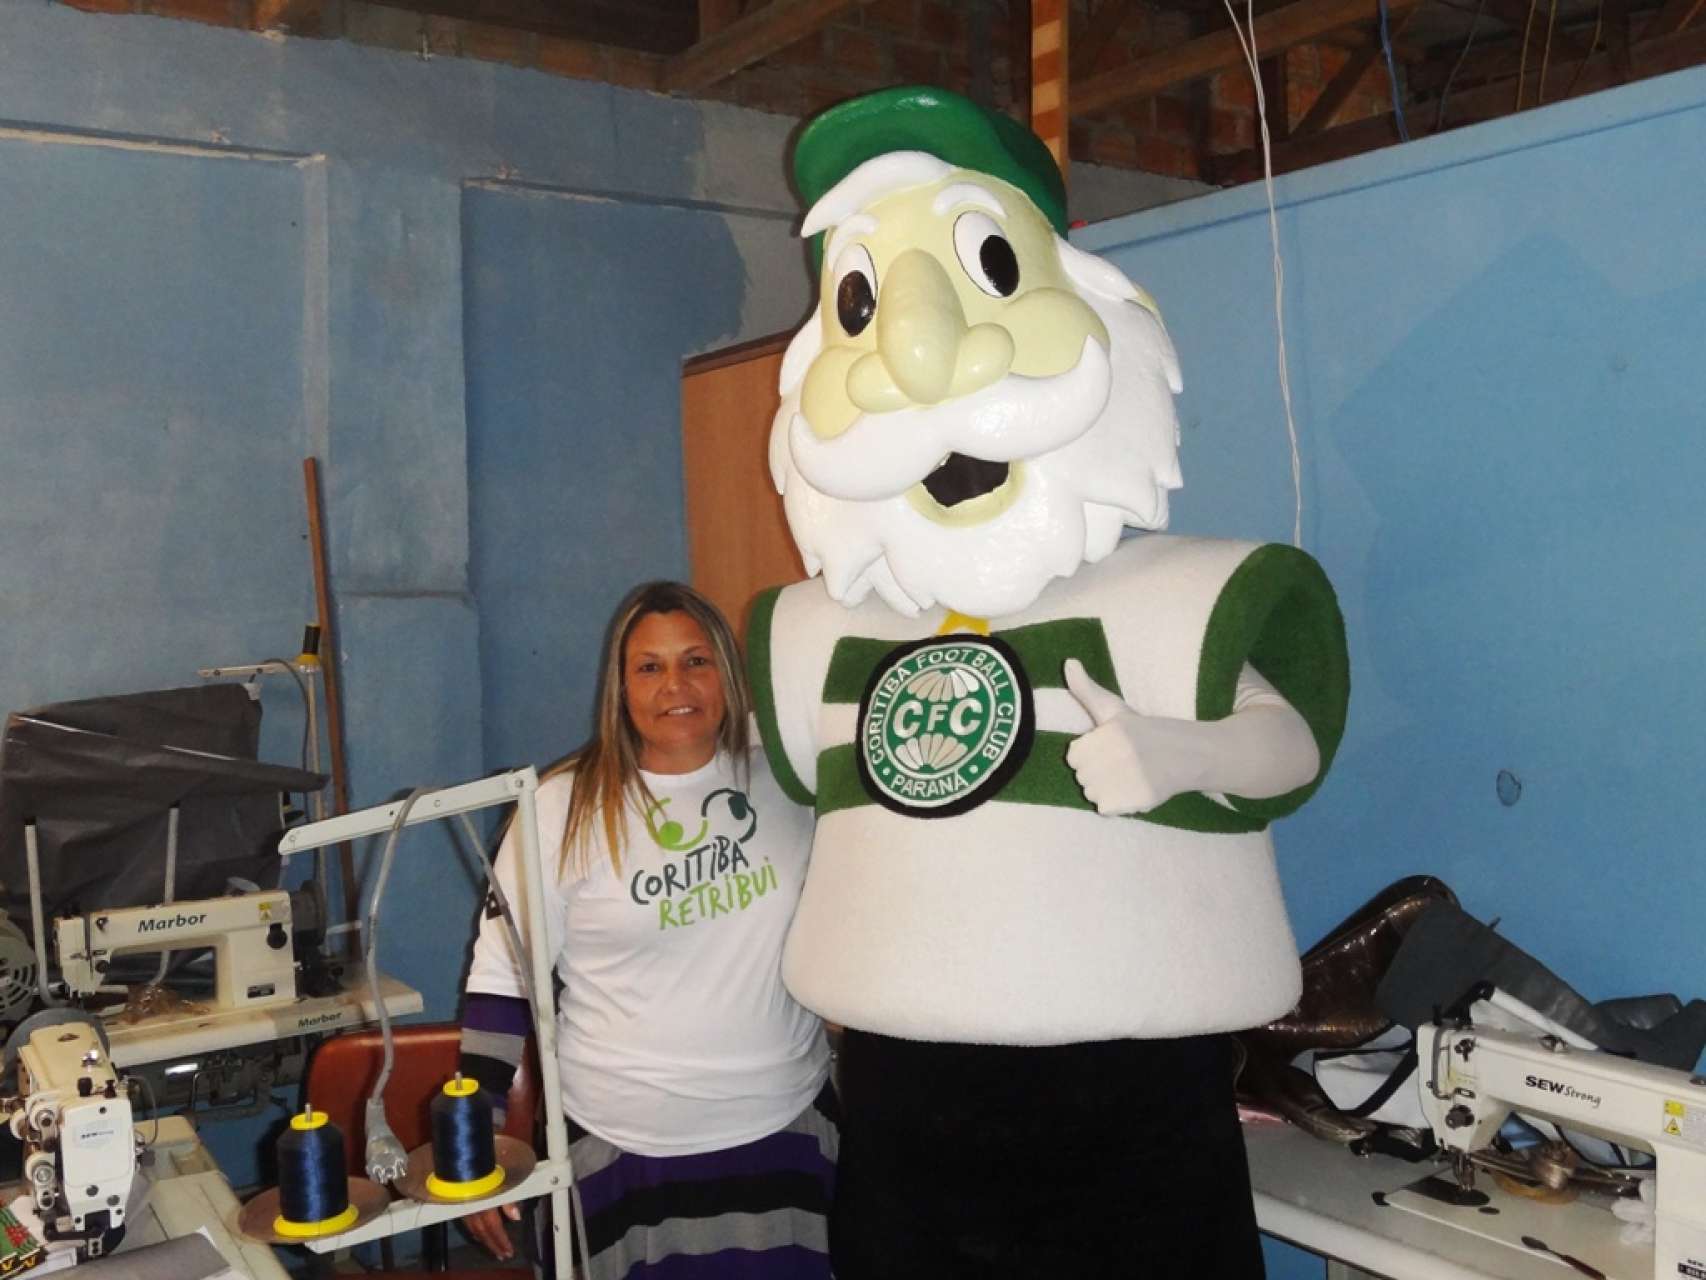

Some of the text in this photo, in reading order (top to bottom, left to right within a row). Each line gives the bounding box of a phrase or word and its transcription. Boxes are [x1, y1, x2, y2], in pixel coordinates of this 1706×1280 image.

[869, 666, 912, 764] CORITIBA
[982, 702, 1014, 761] CLUB
[892, 697, 983, 739] CFC
[137, 913, 208, 933] Marbor
[298, 1012, 342, 1029] Marbor
